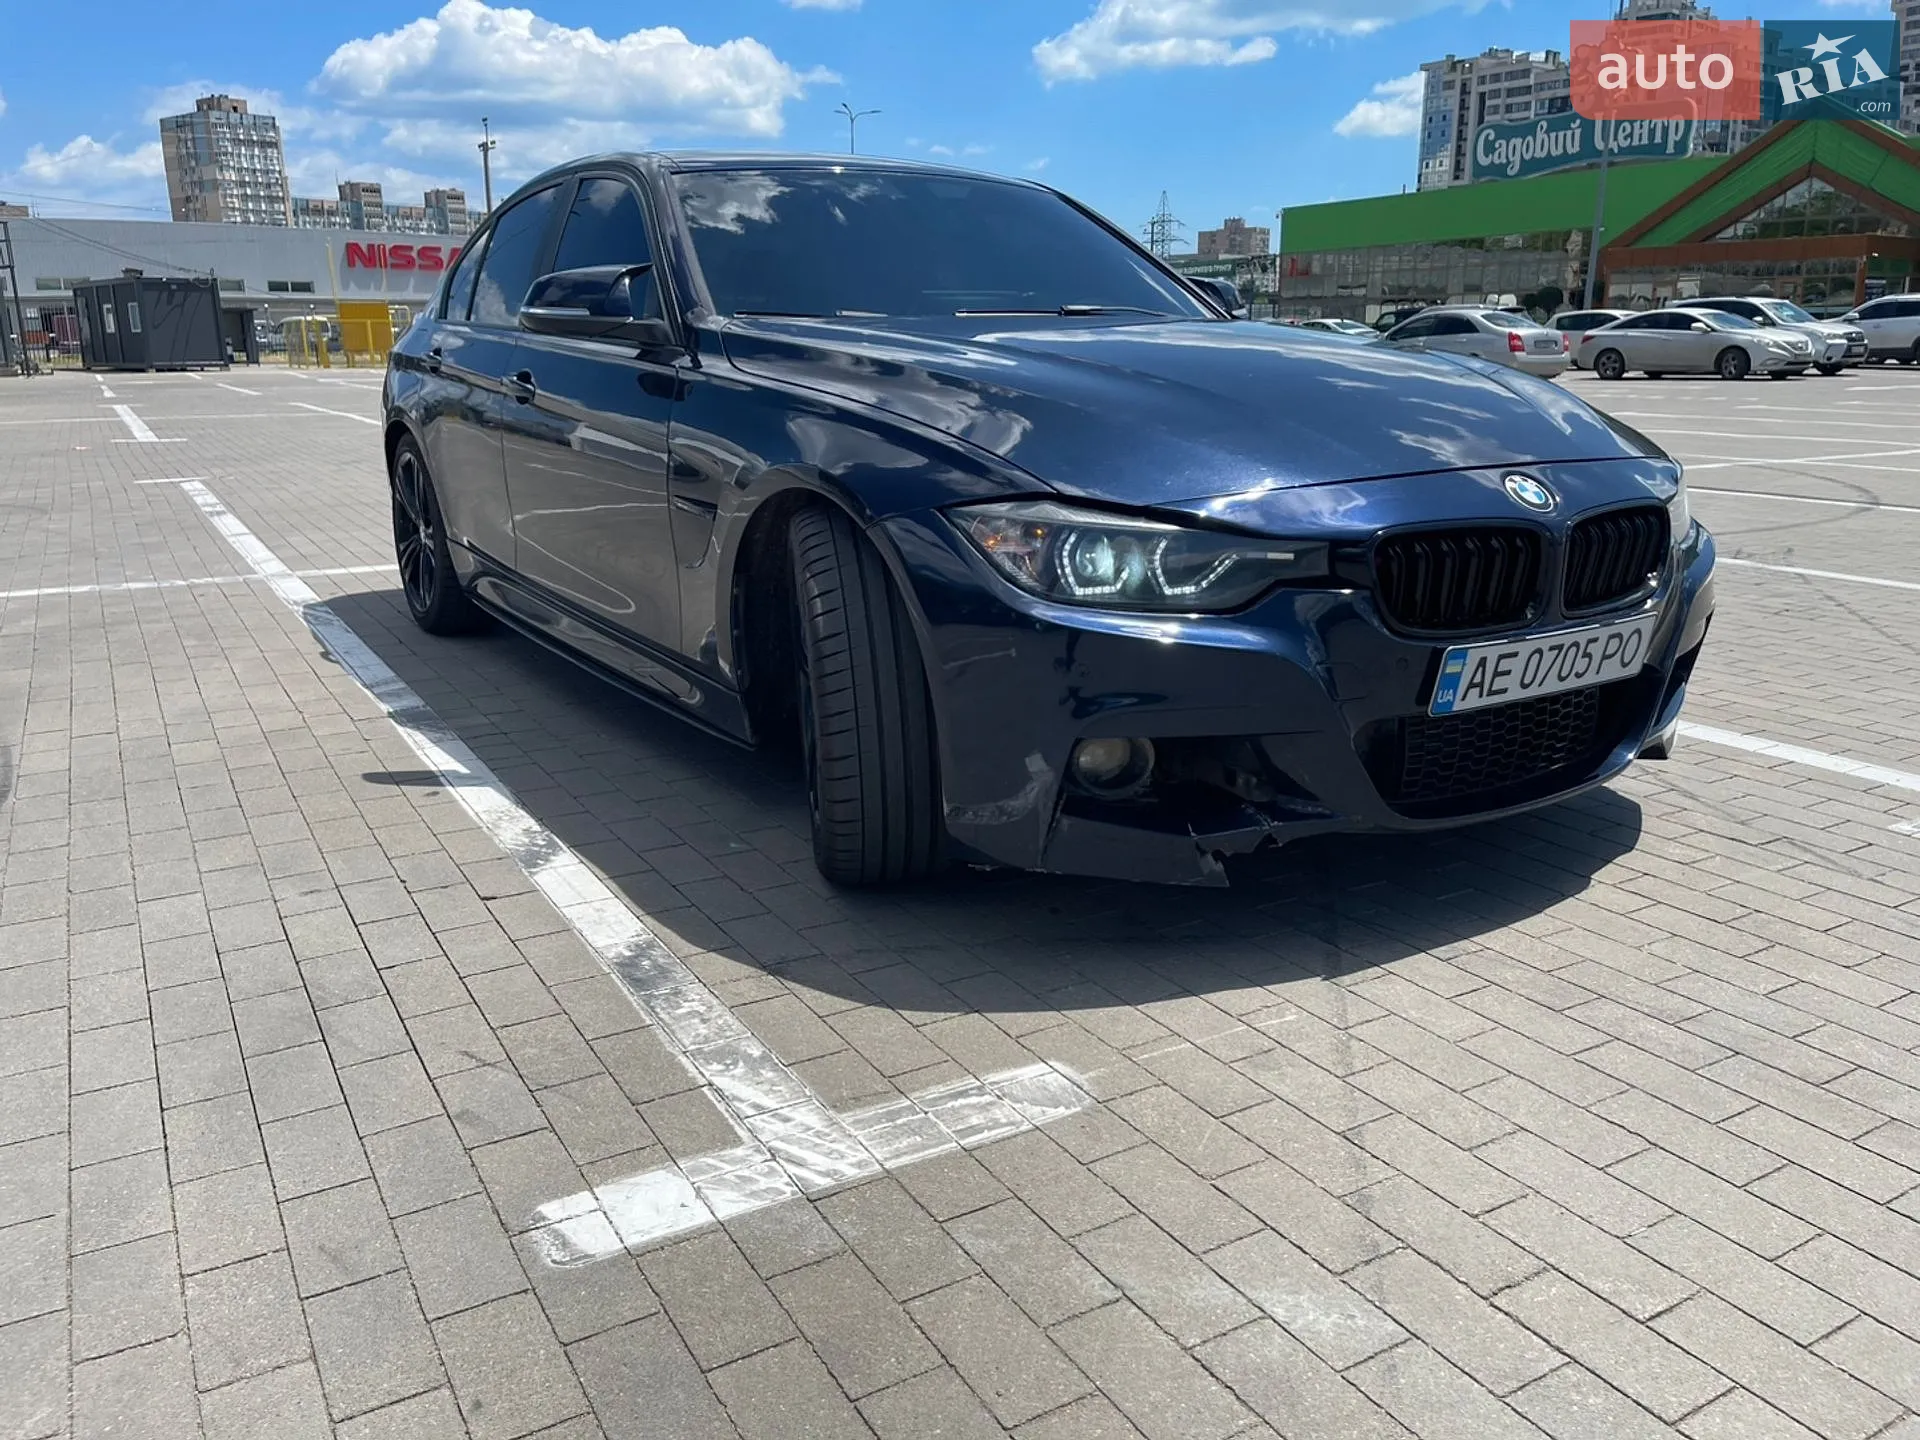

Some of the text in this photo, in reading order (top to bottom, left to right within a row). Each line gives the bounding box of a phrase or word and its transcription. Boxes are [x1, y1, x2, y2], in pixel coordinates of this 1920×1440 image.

[1476, 109, 1685, 176] Садовий Центр
[1437, 689, 1454, 703] UA
[1461, 627, 1643, 702] AE 0705 PO
